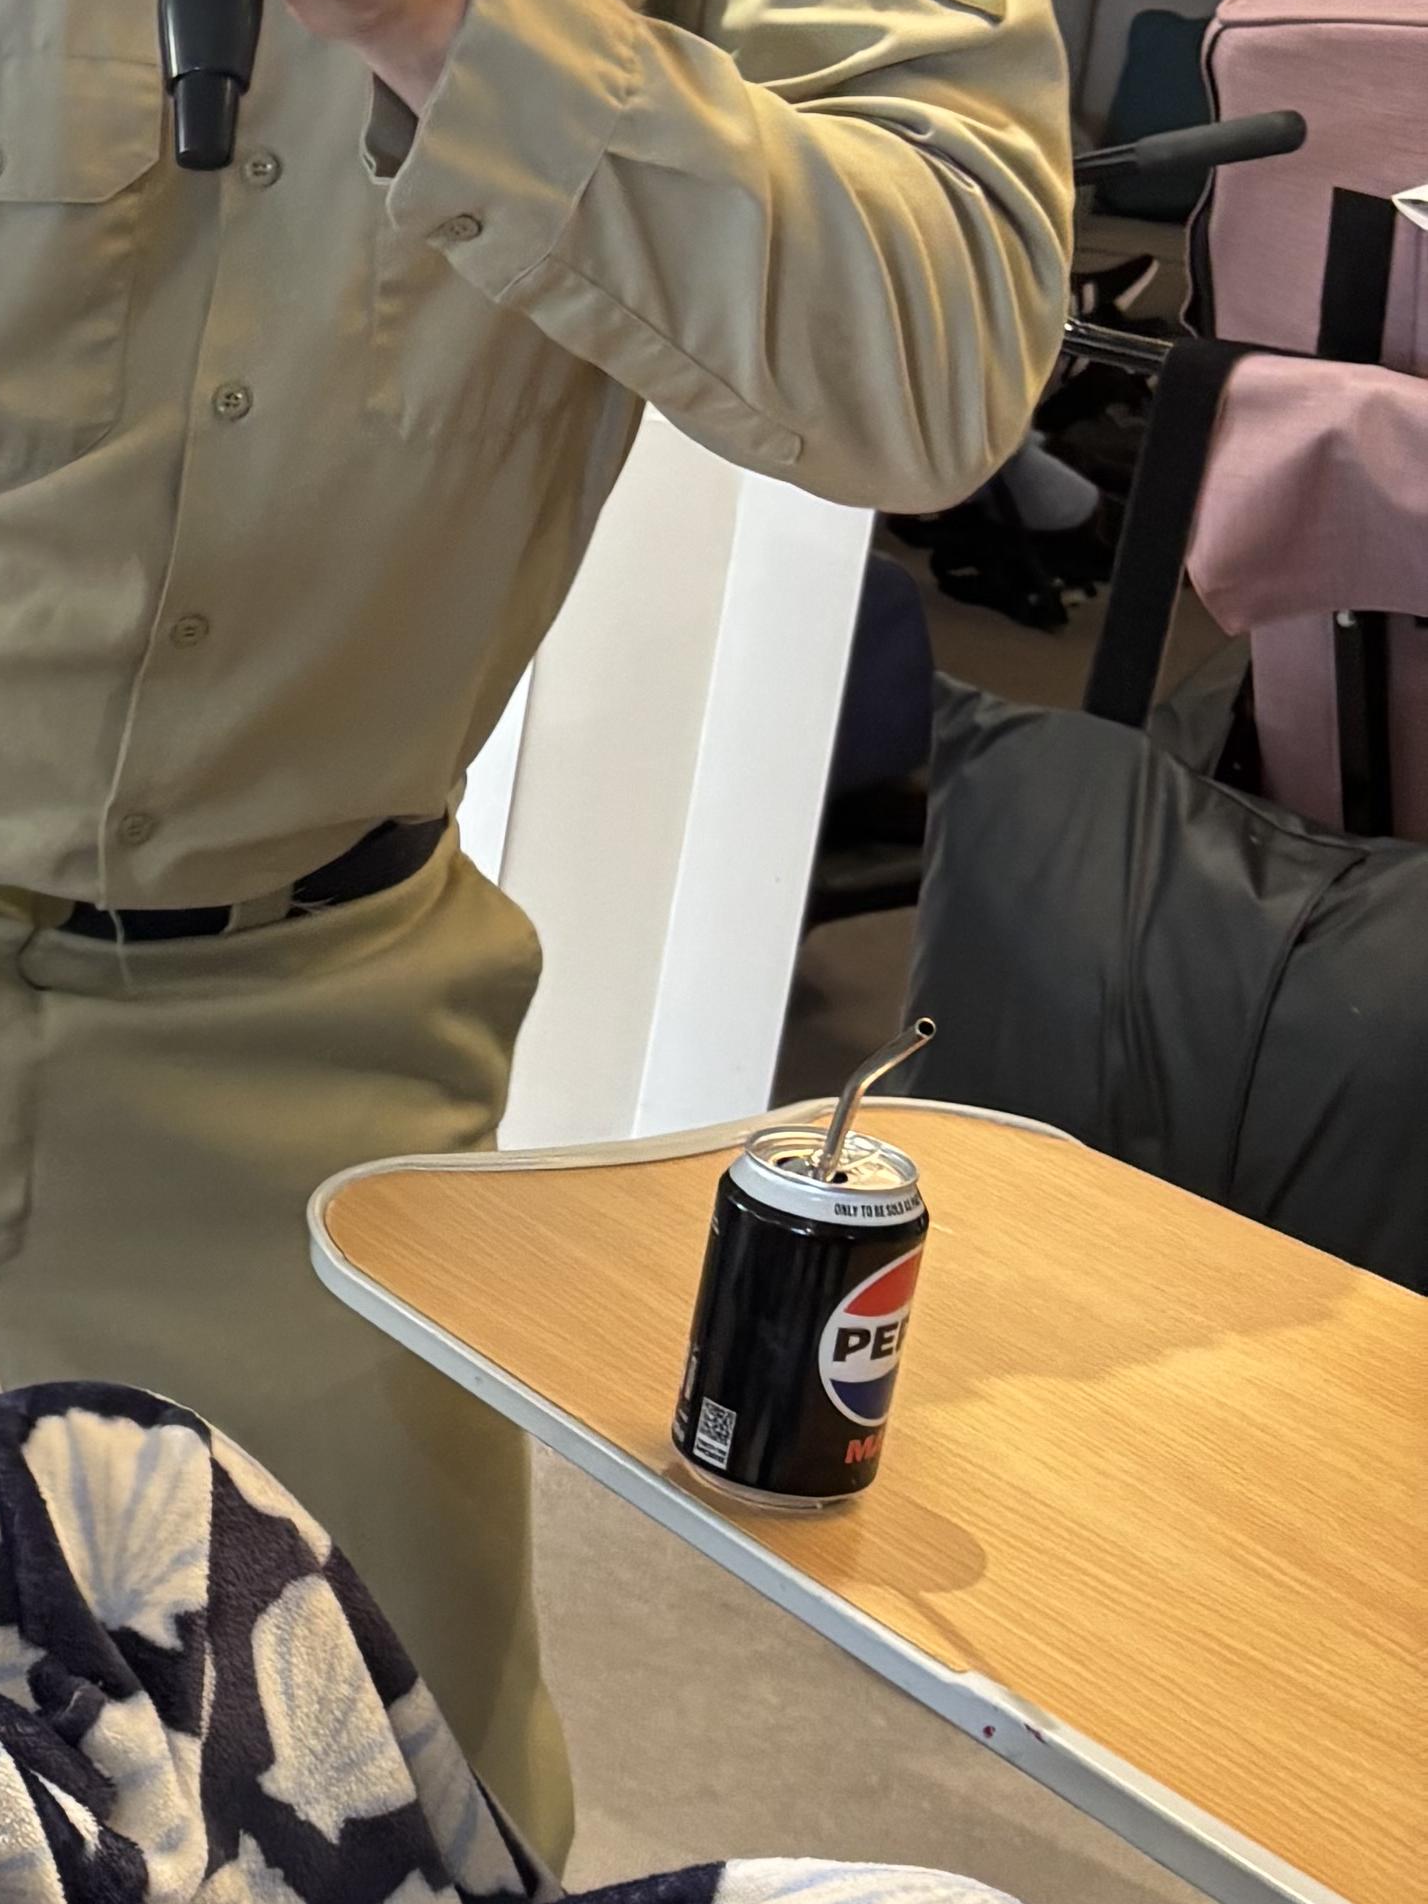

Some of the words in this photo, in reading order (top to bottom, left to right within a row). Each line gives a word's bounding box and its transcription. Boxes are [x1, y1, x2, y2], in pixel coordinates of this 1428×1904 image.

[834, 1202, 858, 1217] ONLY
[861, 1204, 873, 1218] TO
[874, 1204, 885, 1217] BE
[886, 1201, 905, 1216] SOLD
